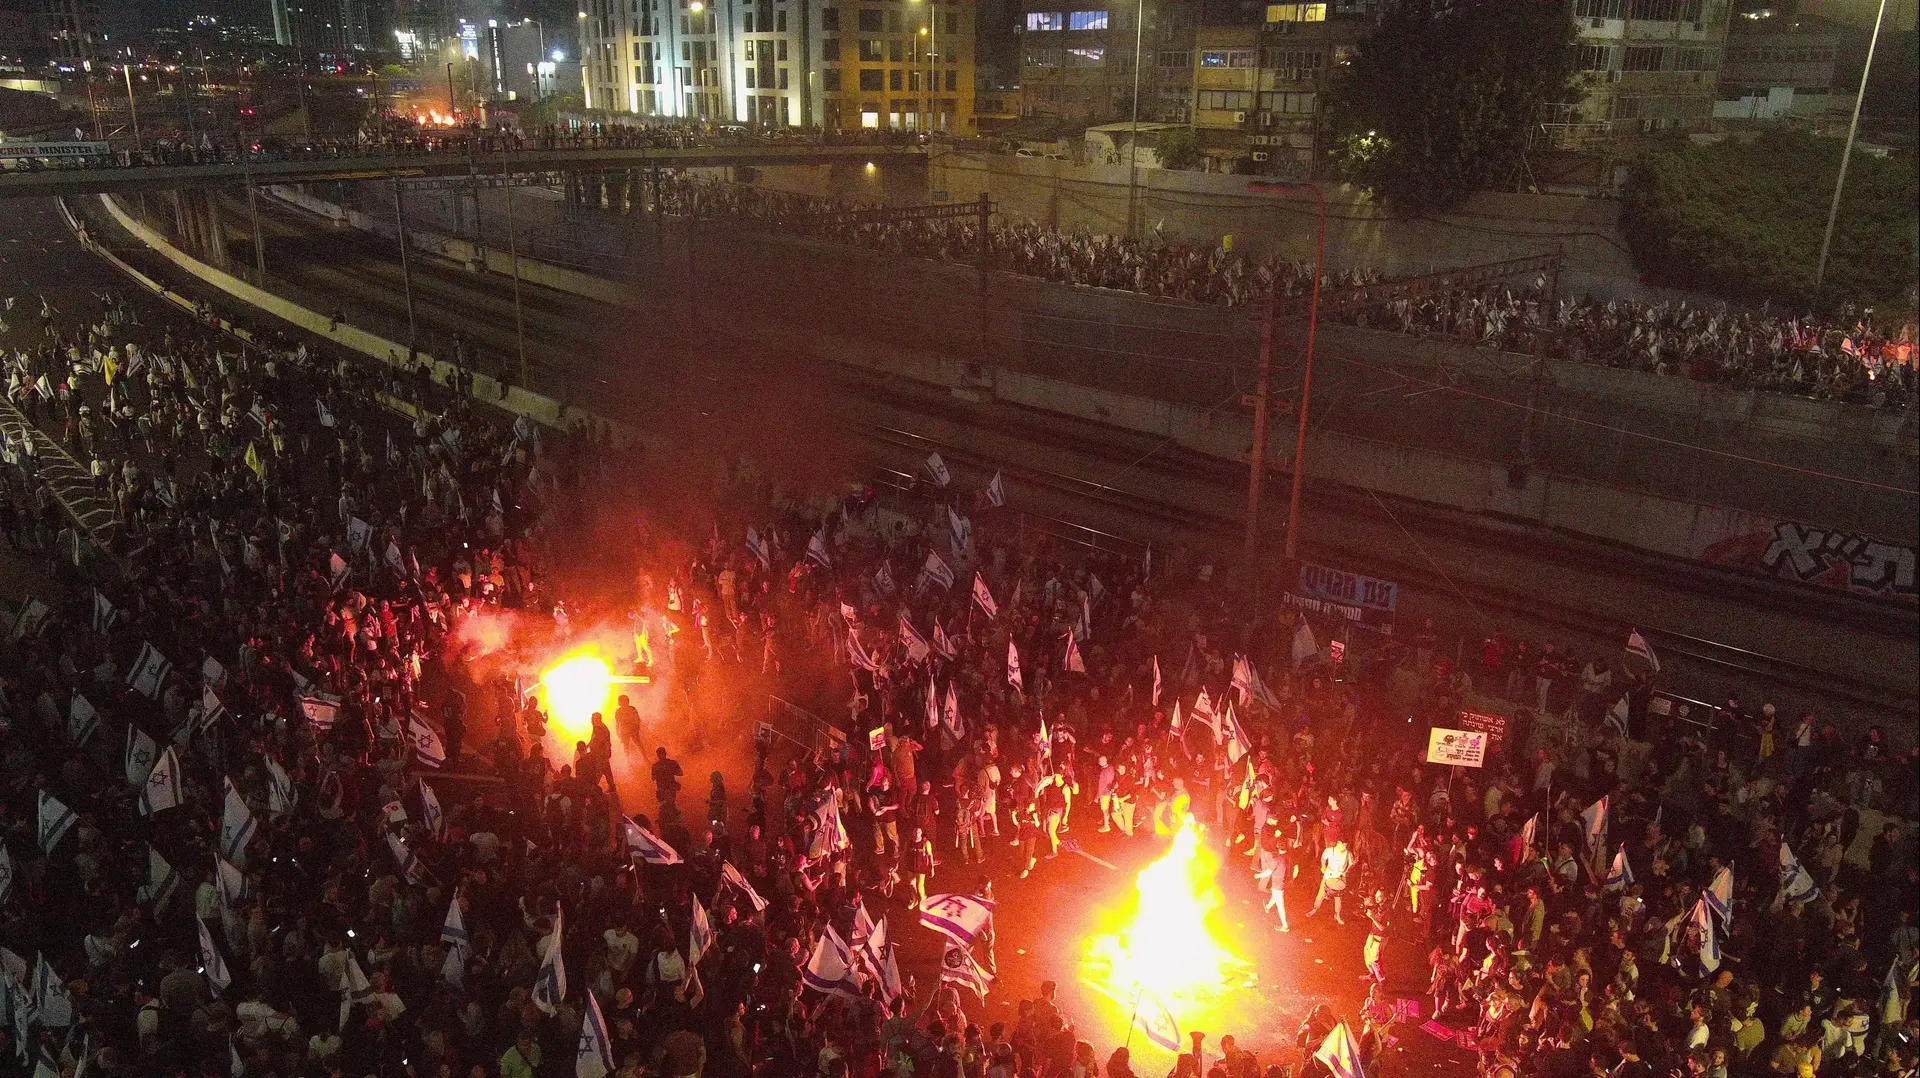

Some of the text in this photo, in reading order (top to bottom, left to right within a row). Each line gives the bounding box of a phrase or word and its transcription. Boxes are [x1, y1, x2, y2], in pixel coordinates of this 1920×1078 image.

[0, 146, 93, 155] CRIME MINISTER
[1496, 716, 1505, 726] לא
